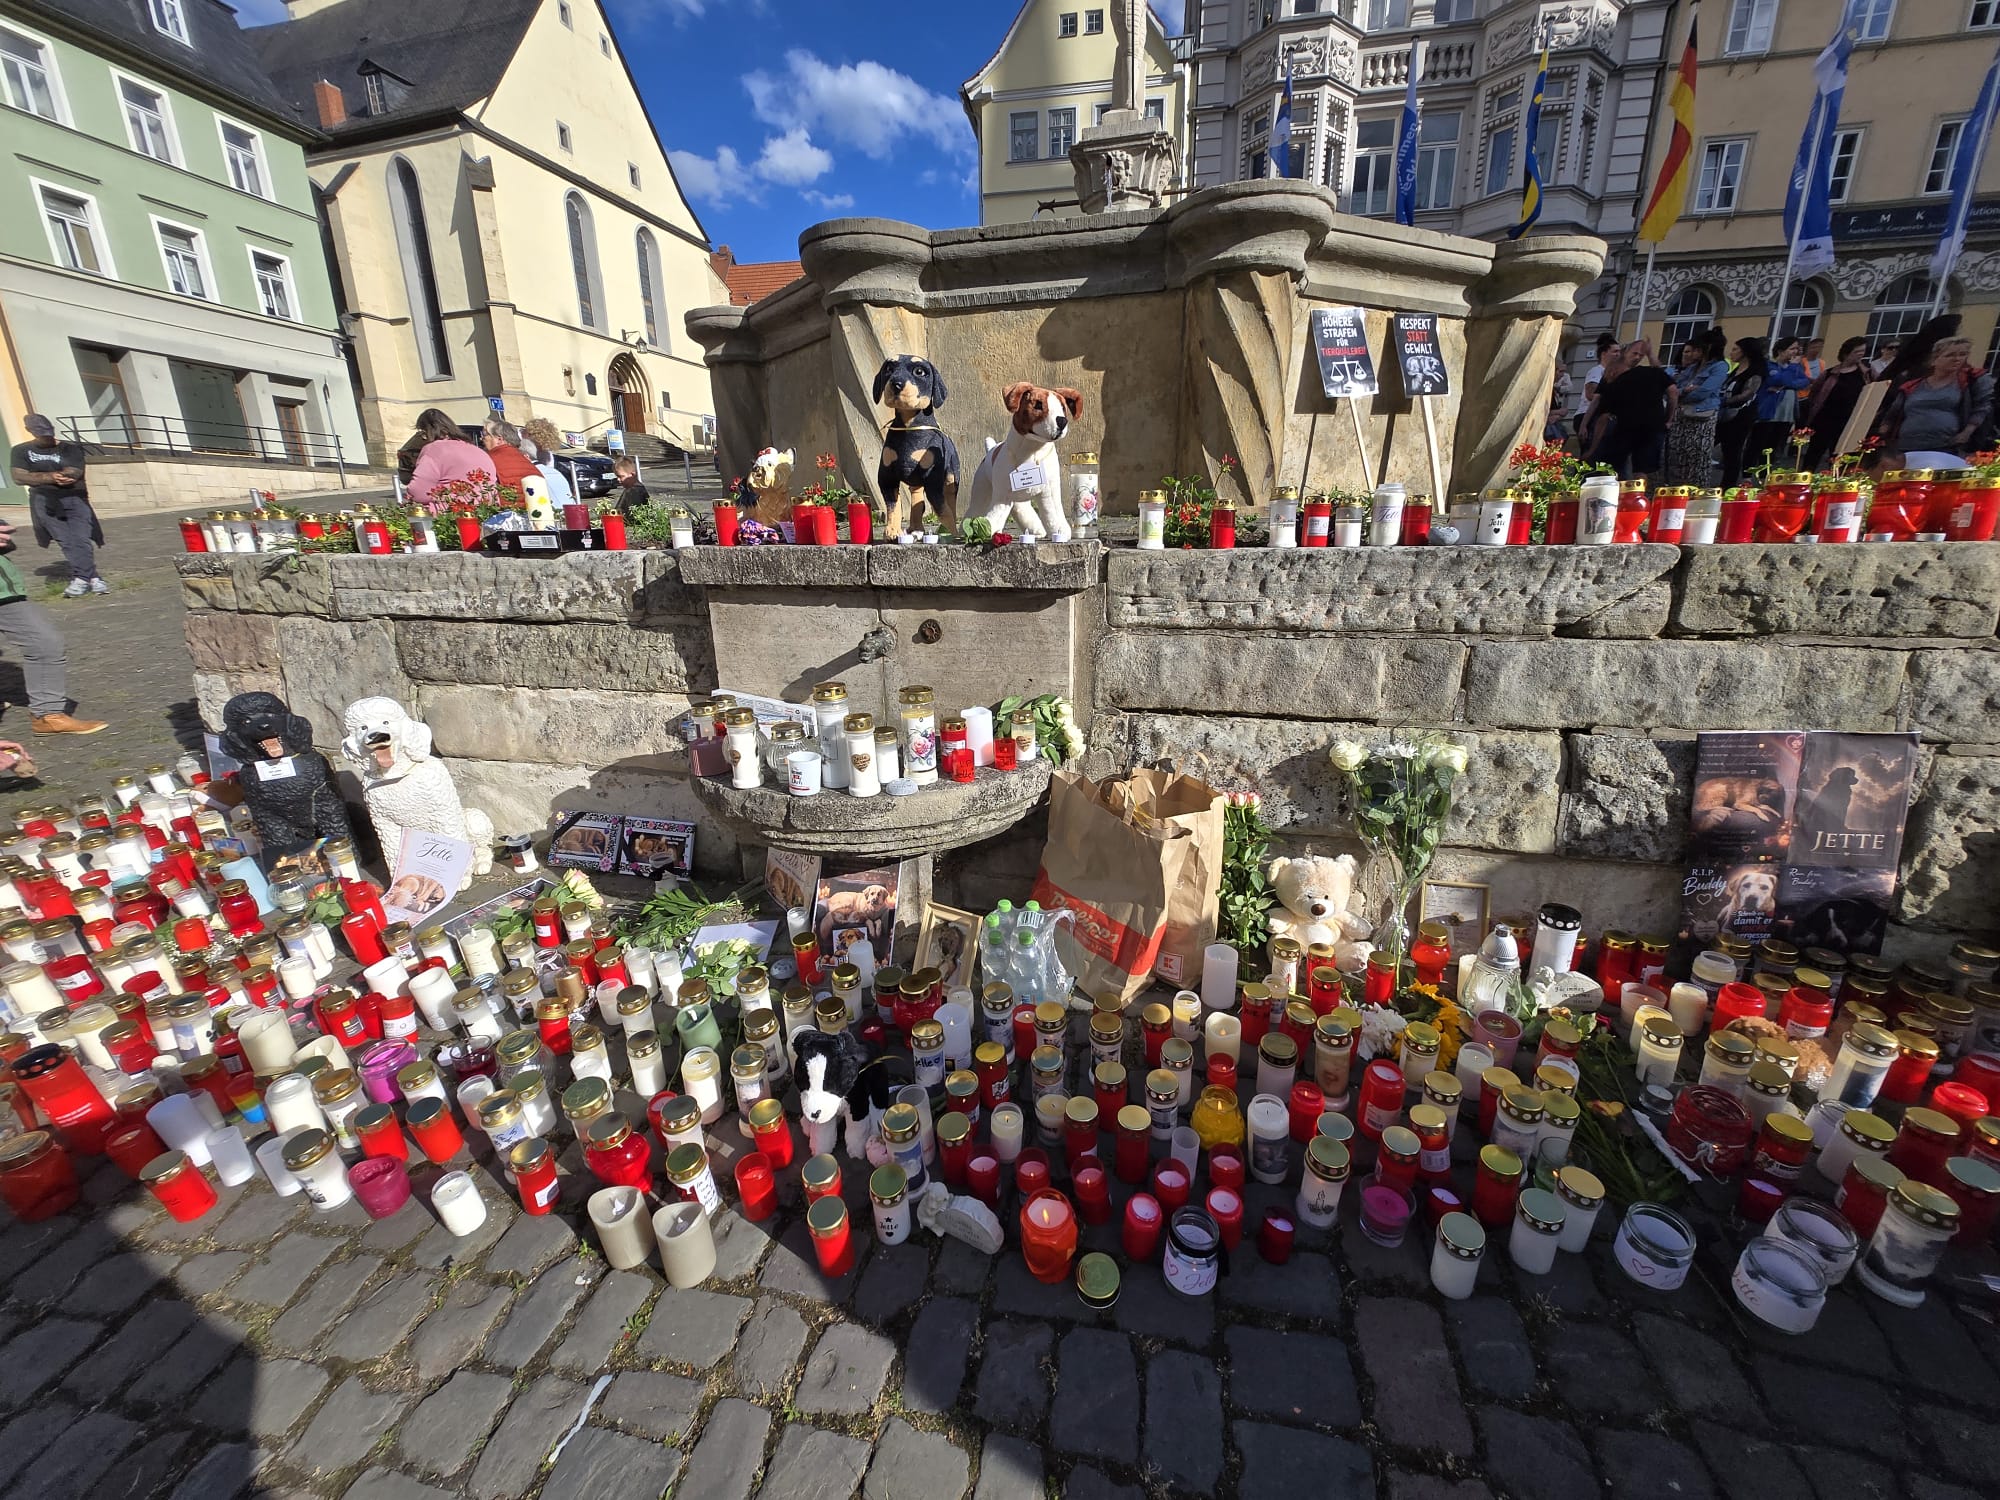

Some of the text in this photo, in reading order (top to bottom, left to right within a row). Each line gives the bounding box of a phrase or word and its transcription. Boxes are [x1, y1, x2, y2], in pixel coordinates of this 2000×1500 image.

[1849, 216, 1858, 226] F
[1879, 214, 1891, 223] M
[1915, 211, 1926, 220] K
[1322, 316, 1353, 327] HÖHERE
[1400, 318, 1431, 330] RESPEKT
[1322, 328, 1357, 338] STRAFEN
[1406, 331, 1428, 342] STATT
[1336, 338, 1349, 347] FÜR
[1404, 343, 1433, 354] GEWALT
[1811, 831, 1886, 852] JETTE
[1682, 876, 1727, 897] Buddy
[1733, 916, 1762, 925] damit
